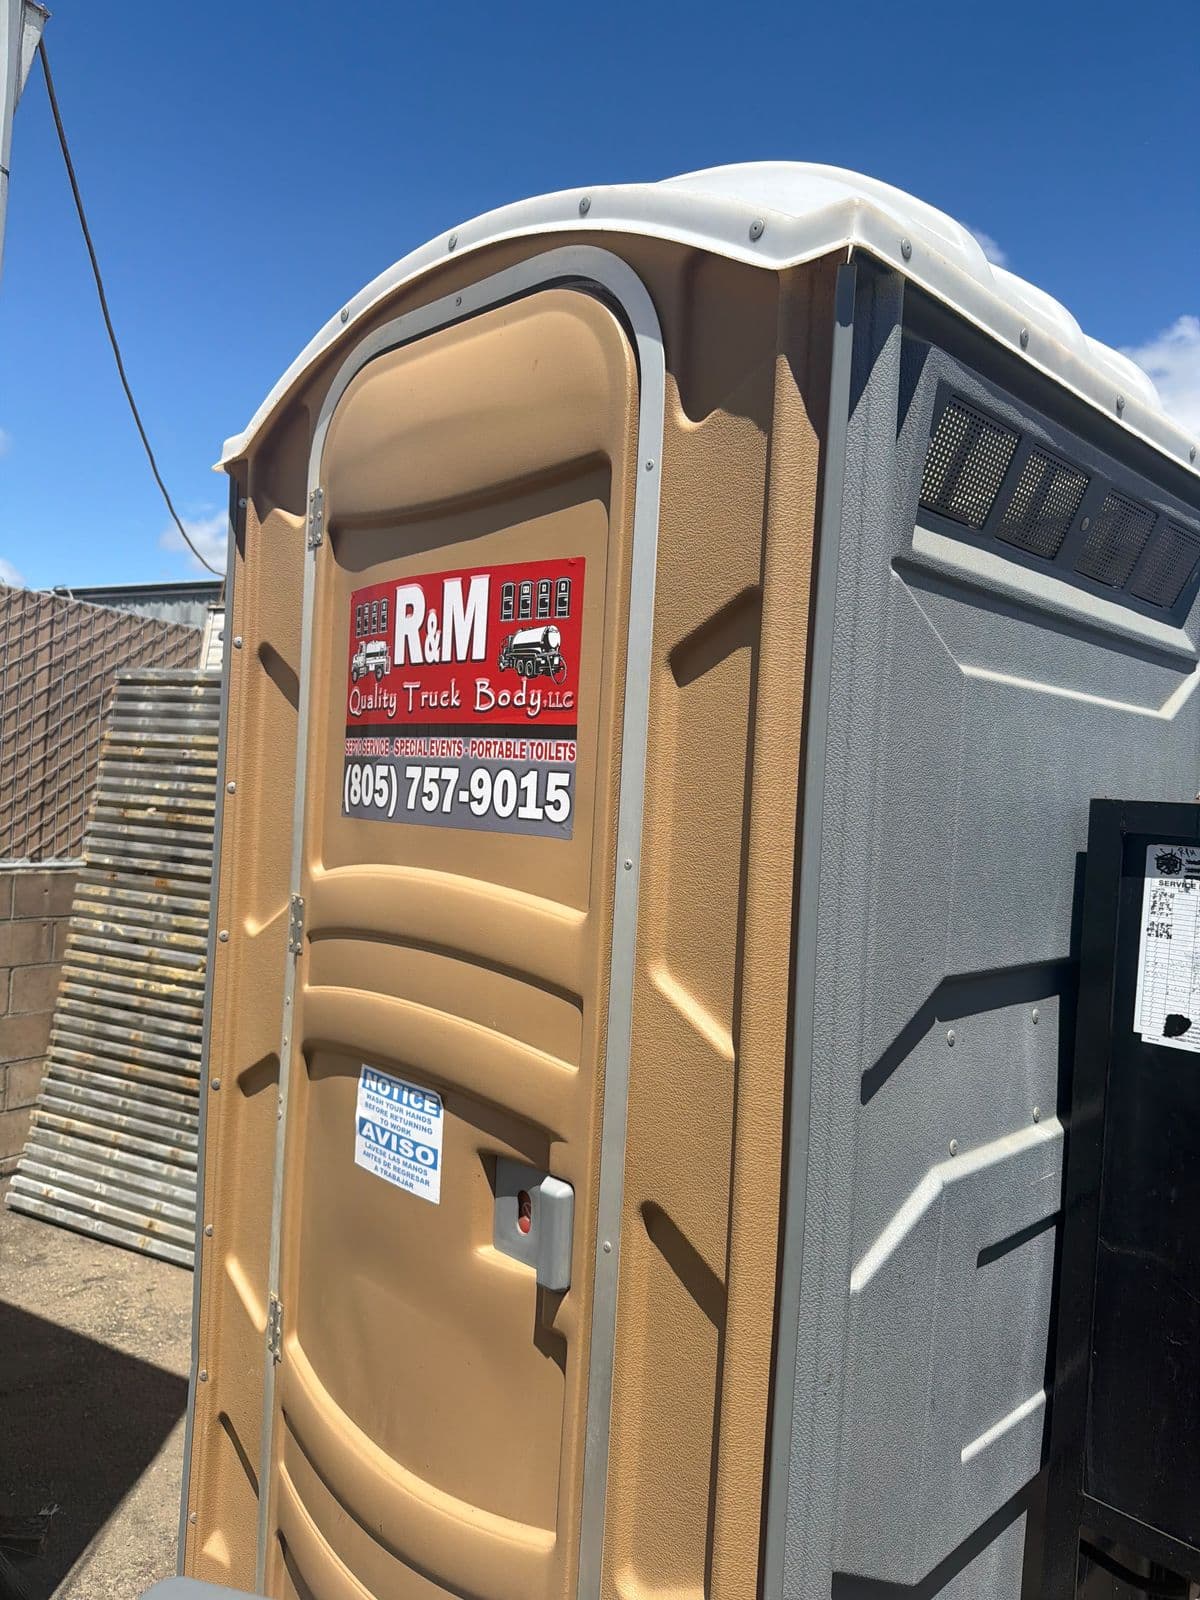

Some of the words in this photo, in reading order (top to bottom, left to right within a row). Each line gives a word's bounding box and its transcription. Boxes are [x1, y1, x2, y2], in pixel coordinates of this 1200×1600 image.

[394, 575, 490, 666] R&M
[349, 683, 397, 717] Quality
[402, 678, 460, 712] Truck
[362, 738, 390, 756] SERVICE
[394, 739, 428, 757] SPECIAL
[429, 739, 464, 758] EVENTS
[470, 741, 526, 760] PORTABLE
[529, 742, 576, 761] TOILETS
[344, 763, 398, 818] (805)
[405, 766, 571, 822] 757-9015
[1159, 879, 1196, 889] SERVICE
[365, 1071, 438, 1115] NOTICE
[366, 1093, 384, 1106] WASH
[385, 1102, 404, 1115] YOUR
[405, 1109, 432, 1125] HANDS
[364, 1101, 389, 1118] BEFORE
[390, 1112, 433, 1135] RETURNING
[380, 1117, 389, 1126] TO
[390, 1123, 412, 1136] WORK
[361, 1121, 435, 1166] AVISO
[364, 1141, 387, 1157] LAVESE
[388, 1153, 401, 1164] LAS
[402, 1160, 428, 1177] MANOS
[363, 1149, 382, 1164] ANTES
[382, 1160, 392, 1170] DE
[392, 1165, 430, 1187] REGRESAR
[380, 1167, 414, 1189] TRABAJAR
